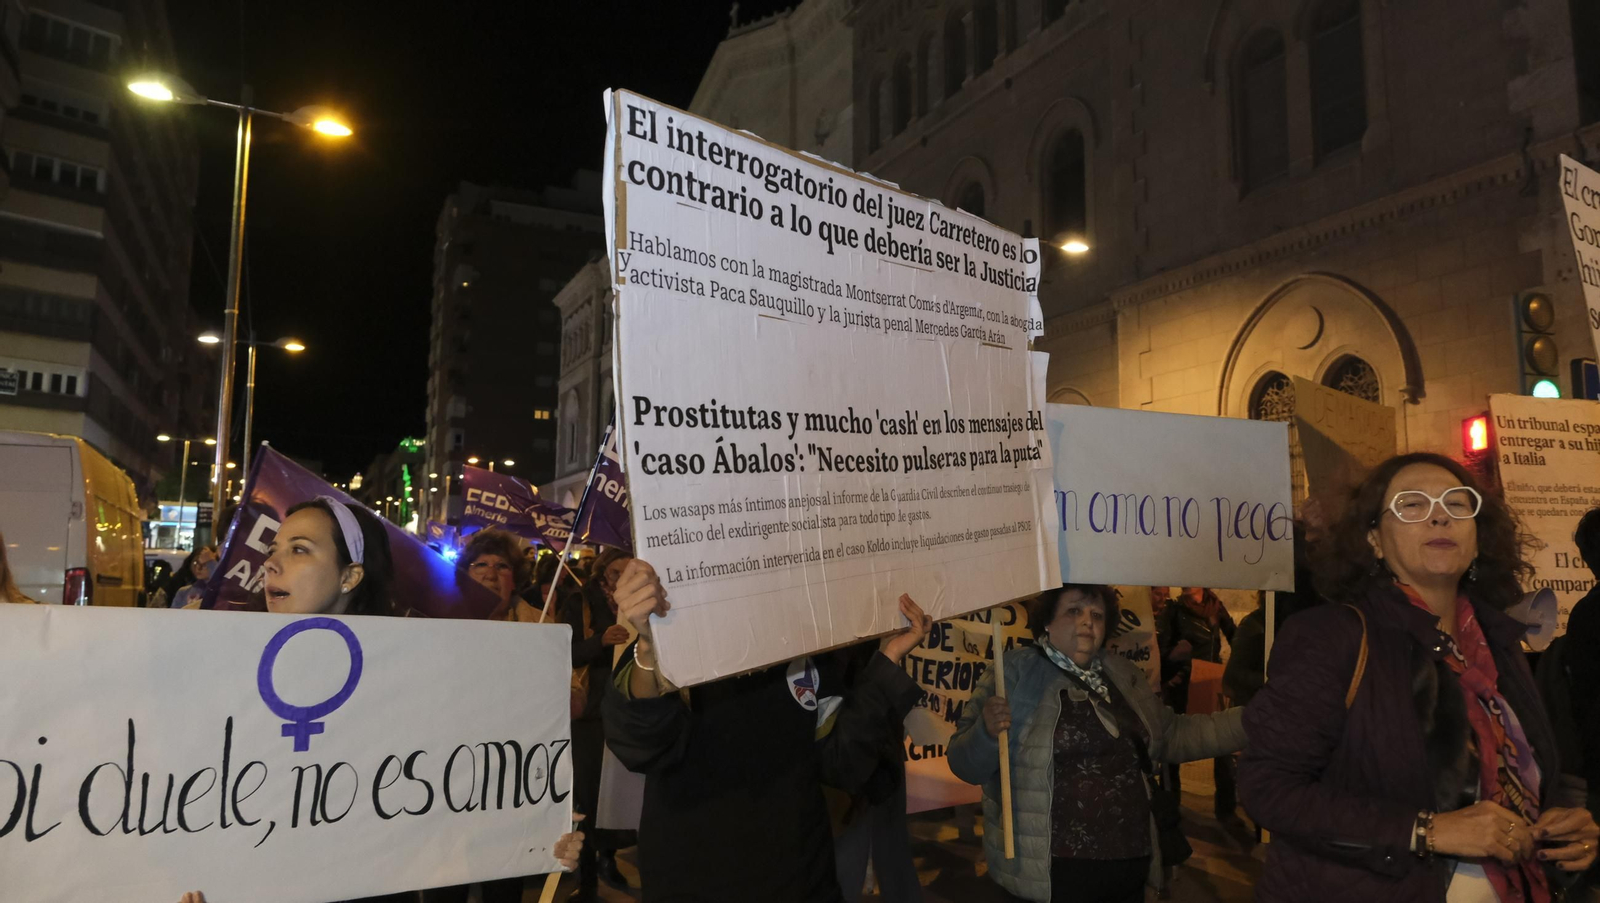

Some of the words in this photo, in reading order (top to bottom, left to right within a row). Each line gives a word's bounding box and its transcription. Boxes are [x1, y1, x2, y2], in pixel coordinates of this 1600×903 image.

[627, 104, 658, 144] El
[667, 116, 847, 208] interrogatorio
[853, 188, 883, 219] del
[887, 197, 924, 231] juez
[930, 211, 999, 255] Carretero
[1002, 243, 1016, 263] es
[1019, 242, 1038, 264] lo
[1564, 166, 1580, 201] El
[627, 159, 763, 220] contrario
[770, 205, 784, 228] a
[790, 203, 812, 236] lo
[818, 220, 859, 255] que
[864, 228, 932, 266] debería
[936, 252, 960, 272] ser
[964, 254, 976, 278] la
[980, 261, 1037, 293] Justicia
[619, 251, 632, 272] y
[630, 268, 705, 296] activista
[710, 280, 746, 304] Paca
[749, 288, 814, 318] Sauquillo
[817, 307, 826, 324] y
[829, 305, 841, 323] la
[843, 308, 881, 329] jurista
[883, 317, 913, 334] penal
[915, 319, 959, 338] Mercedes
[960, 325, 987, 341] García
[988, 329, 1006, 344] Arán
[629, 231, 717, 268] Hablamos
[720, 257, 749, 276] con
[752, 259, 765, 279] la
[769, 266, 842, 298] magistrada
[846, 283, 907, 308] Montserrat
[986, 310, 1000, 324] con
[1001, 310, 1009, 325] la
[632, 395, 782, 431] Prostitutas
[786, 412, 799, 440] y
[804, 407, 872, 435] mucho
[876, 408, 918, 435] 'cash'
[923, 418, 942, 435] en
[944, 410, 965, 434] los
[968, 412, 1023, 439] mensajes
[1025, 410, 1044, 432] del
[1496, 415, 1516, 429] Un
[1517, 417, 1570, 432] tribunal
[634, 440, 705, 476] 'caso
[902, 446, 967, 474] pulseras
[970, 449, 998, 471] para
[999, 441, 1012, 464] la
[1013, 438, 1043, 468] puta"
[1500, 435, 1556, 451] entregar
[1558, 441, 1566, 450] a
[1568, 440, 1584, 451] su
[1502, 453, 1511, 465] a
[1513, 452, 1546, 466] Italia
[642, 504, 667, 521] Los
[669, 502, 715, 521] wasaps
[718, 498, 743, 515] más
[745, 497, 787, 512] íntimos
[833, 490, 868, 505] informe
[870, 489, 880, 502] de
[881, 489, 889, 502] la
[921, 487, 939, 500] Civil
[1089, 491, 1158, 536] ama
[1162, 496, 1199, 539] no
[646, 529, 704, 548] metálico
[707, 523, 725, 541] del
[728, 519, 790, 540] exdirigente
[791, 515, 837, 532] socialista
[838, 516, 858, 531] para
[860, 512, 878, 524] todo
[879, 512, 896, 528] tipo
[907, 510, 932, 526] gastos.
[666, 567, 683, 584] La
[686, 557, 761, 581] información
[763, 549, 821, 570] intervenida
[823, 549, 835, 560] en
[836, 542, 845, 557] el
[846, 544, 865, 556] caso
[866, 540, 890, 553] Koldo
[891, 536, 919, 553] incluye
[965, 529, 973, 540] de
[1554, 552, 1569, 568] El
[78, 716, 277, 848] duele,
[291, 760, 359, 829] no
[371, 750, 435, 820] es
